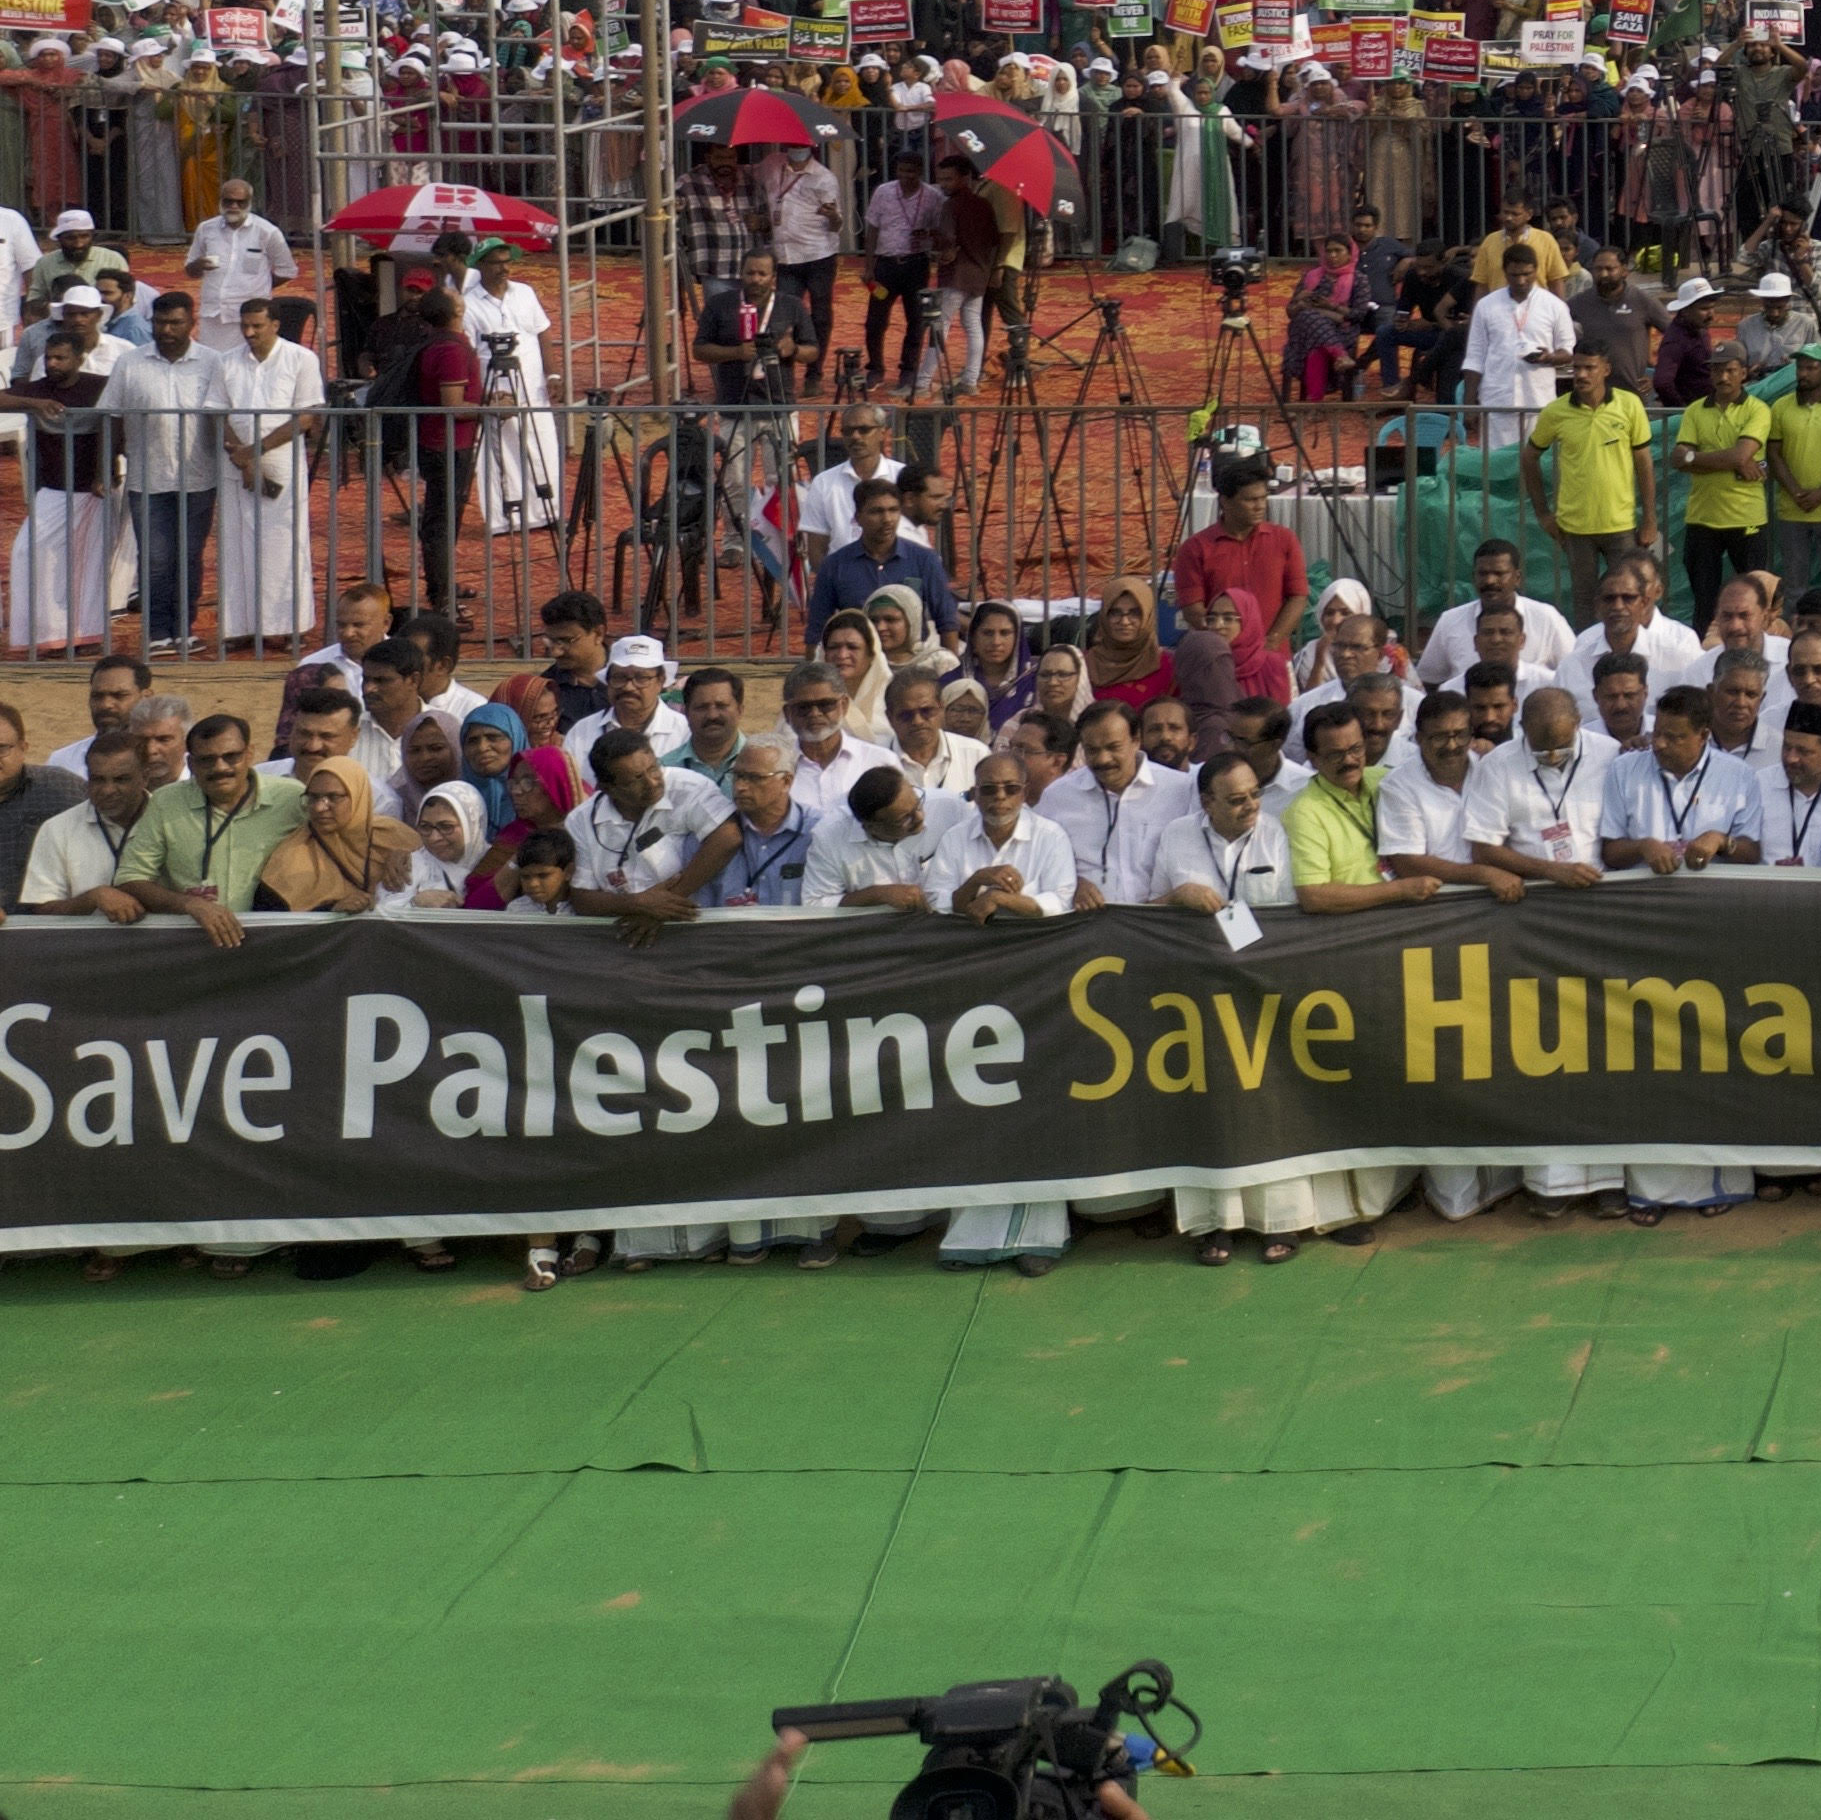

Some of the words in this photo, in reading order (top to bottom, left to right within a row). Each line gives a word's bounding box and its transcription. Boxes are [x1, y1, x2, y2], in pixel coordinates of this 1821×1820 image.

[1616, 13, 1643, 22] SAVE
[1613, 21, 1643, 32] GAZA
[1533, 31, 1555, 39] PRAY
[1558, 31, 1573, 39] FOR
[1529, 43, 1574, 52] PALESTINE
[1068, 956, 1356, 1101] Save
[0, 1002, 292, 1149] Save
[341, 984, 1025, 1139] Palestine
